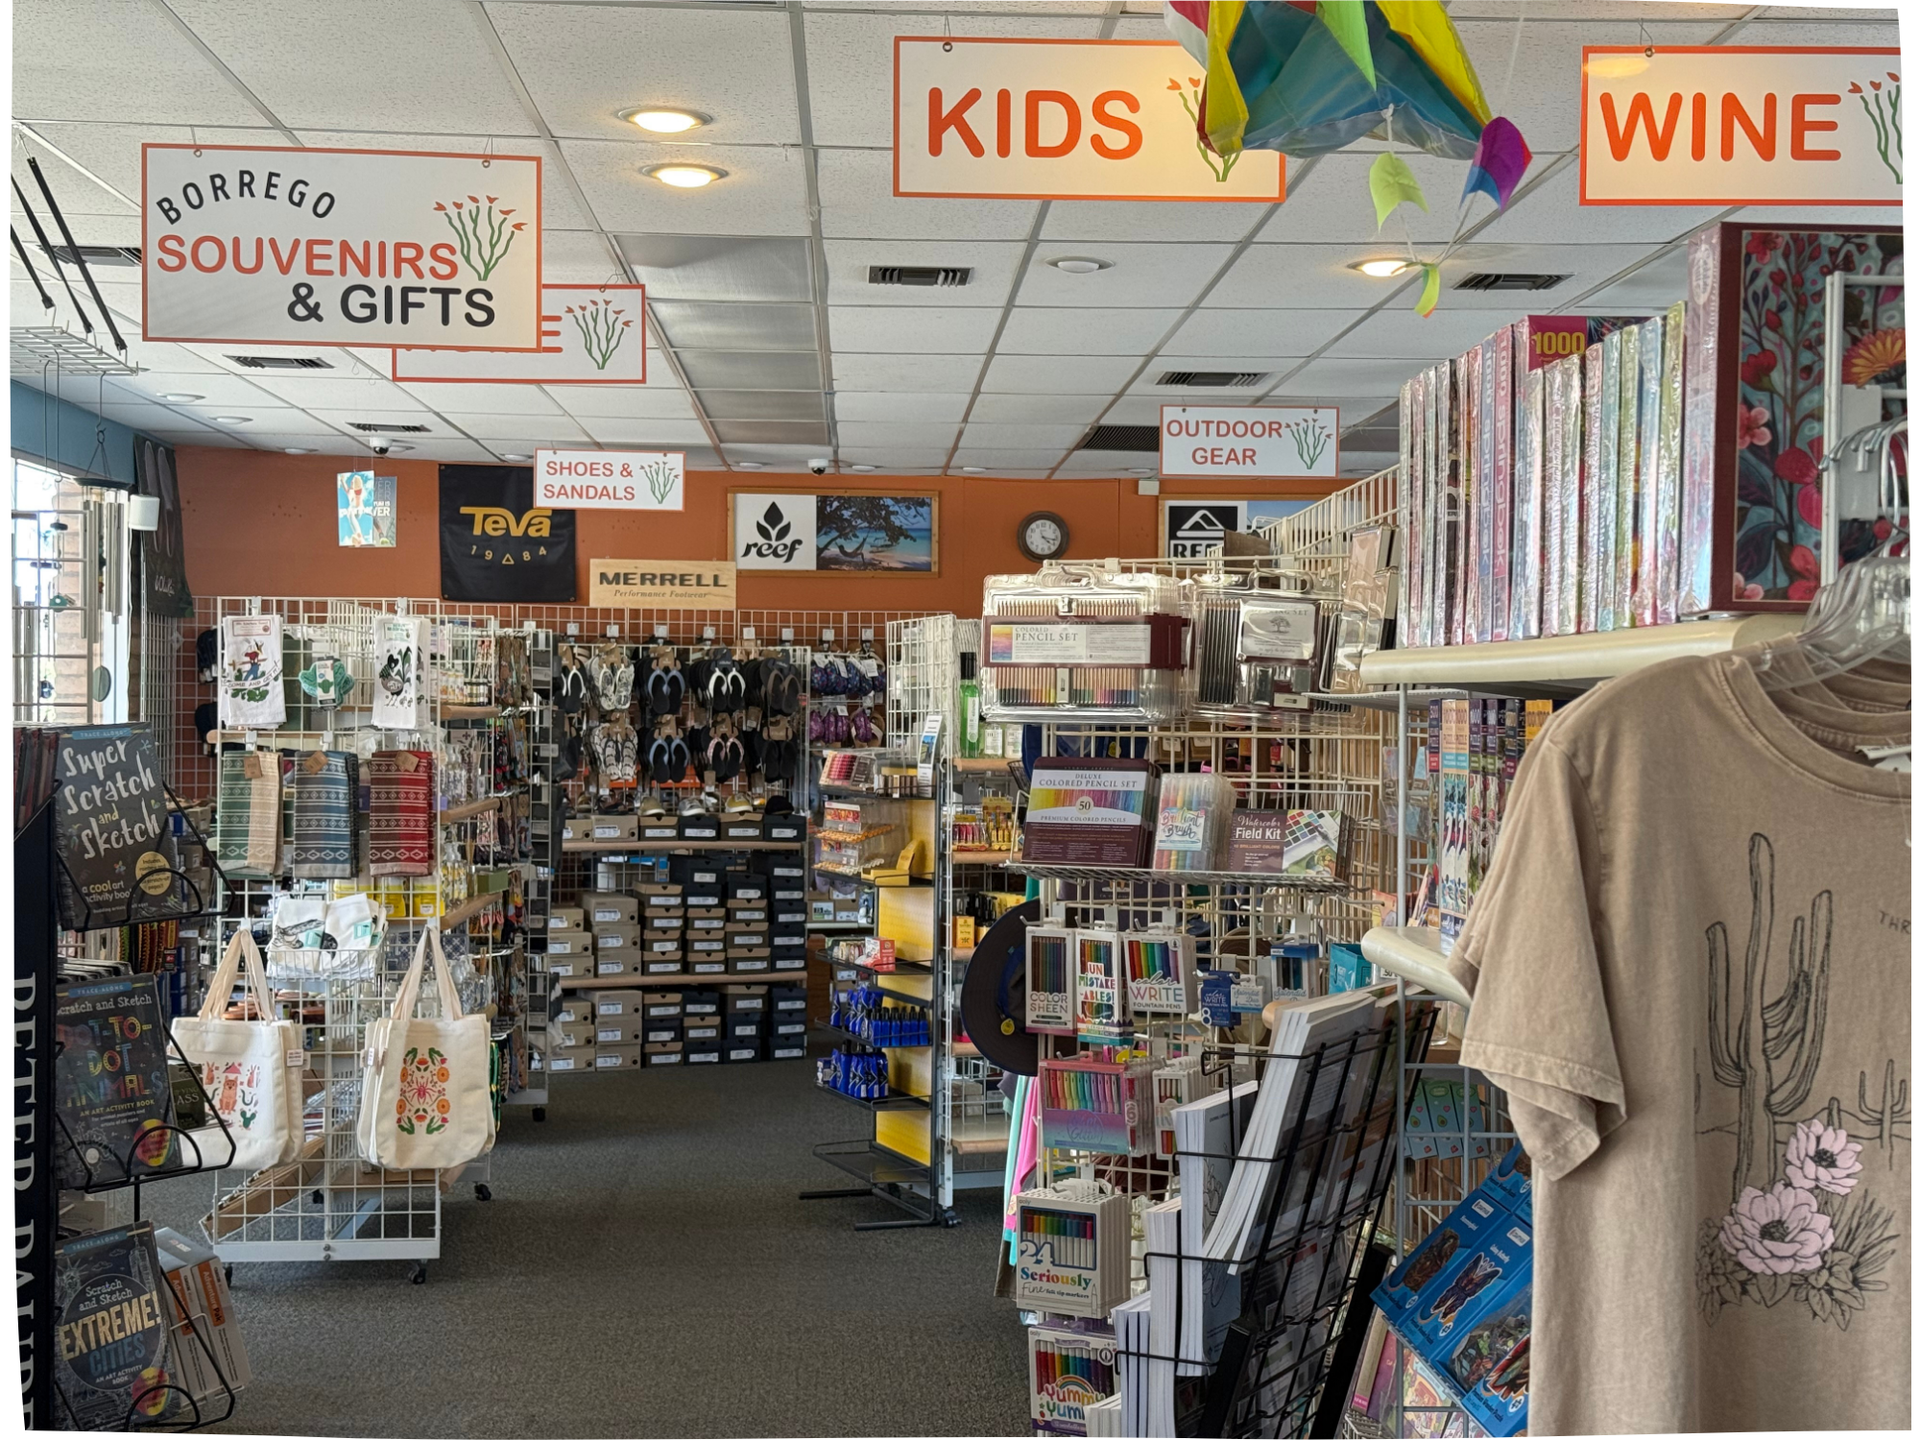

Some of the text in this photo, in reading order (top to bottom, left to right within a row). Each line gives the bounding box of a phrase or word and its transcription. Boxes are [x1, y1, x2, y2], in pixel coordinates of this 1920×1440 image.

[928, 87, 1143, 160] KIDS
[1600, 92, 1841, 162] WINE
[156, 169, 335, 224] BORREGO
[157, 234, 458, 280] SOUVENIRS
[287, 282, 495, 327] & GIFTS
[1535, 332, 1585, 354] 1000
[1166, 420, 1282, 438] OUTDOOR
[1191, 447, 1257, 466] GEAR
[546, 460, 633, 478] SHOES &
[543, 484, 635, 501] SANDALS
[1495, 405, 1508, 568] springbok
[741, 539, 803, 563] reef
[599, 572, 728, 587] MERRELL
[614, 589, 708, 598] Performance Footwear
[1015, 633, 1078, 641] PENCIL SET
[62, 740, 126, 780] Super
[64, 751, 156, 815] Scratch
[1085, 780, 1118, 788] PENCIL
[98, 803, 119, 824] and
[1079, 801, 1091, 810] 50
[1161, 807, 1202, 827] Brilliant
[1237, 815, 1280, 827] Watercolor
[81, 797, 161, 859] Sketch
[1235, 827, 1281, 839] Field Kit
[89, 880, 111, 893] cool
[112, 880, 124, 889] art
[1089, 964, 1102, 975] UN
[1135, 971, 1180, 986] color
[95, 998, 115, 1008] and
[117, 994, 152, 1007] Sketch
[1030, 993, 1068, 1004] COLOR
[1129, 985, 1184, 1002] WRITE
[1030, 1003, 1068, 1013] SHEEN
[1201, 1007, 1212, 1025] 8
[88, 1043, 132, 1076] DOT
[80, 1109, 91, 1117] AN
[105, 1103, 135, 1113] ACTIVITY
[136, 1099, 156, 1107] BOOK
[1020, 1241, 1053, 1265] 24
[1020, 1266, 1092, 1290] Seriously
[85, 1279, 123, 1297] Scratch
[1022, 1281, 1046, 1297] Fine
[1066, 1291, 1089, 1299] markers
[79, 1288, 133, 1311] and Sketch
[58, 1290, 162, 1361] EXTREME!
[89, 1333, 146, 1376] CITIES
[118, 1364, 143, 1376] ACTIVITY
[112, 1375, 129, 1384] BOOK
[1045, 1383, 1106, 1405] Yummy
